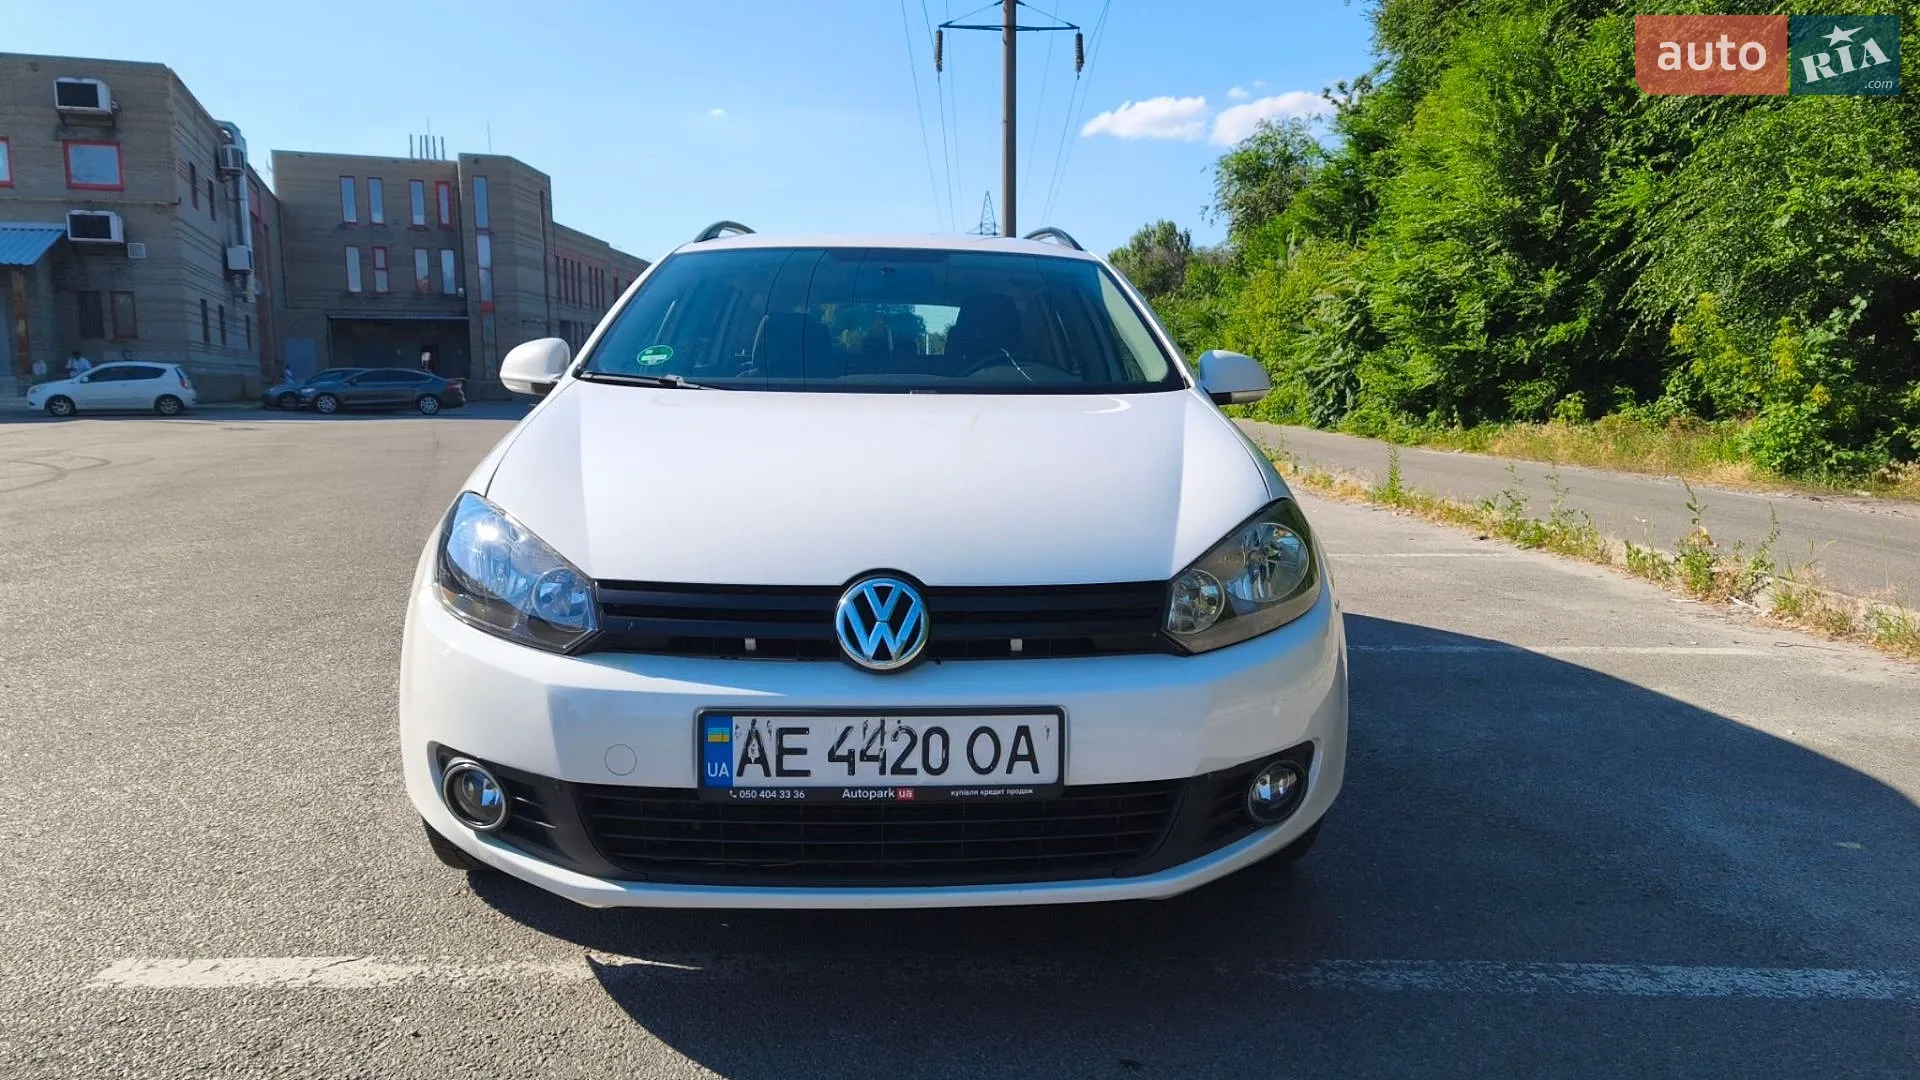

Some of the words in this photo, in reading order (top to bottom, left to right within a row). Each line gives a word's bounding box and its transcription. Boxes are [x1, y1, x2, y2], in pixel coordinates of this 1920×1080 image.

[736, 726, 812, 778] AE
[827, 724, 950, 777] 4420
[966, 724, 1041, 776] OA
[707, 762, 730, 777] UA
[739, 789, 757, 799] 050
[758, 789, 777, 799] 404
[779, 789, 791, 799] 33
[793, 789, 806, 799] 36
[842, 788, 896, 801] Autopark
